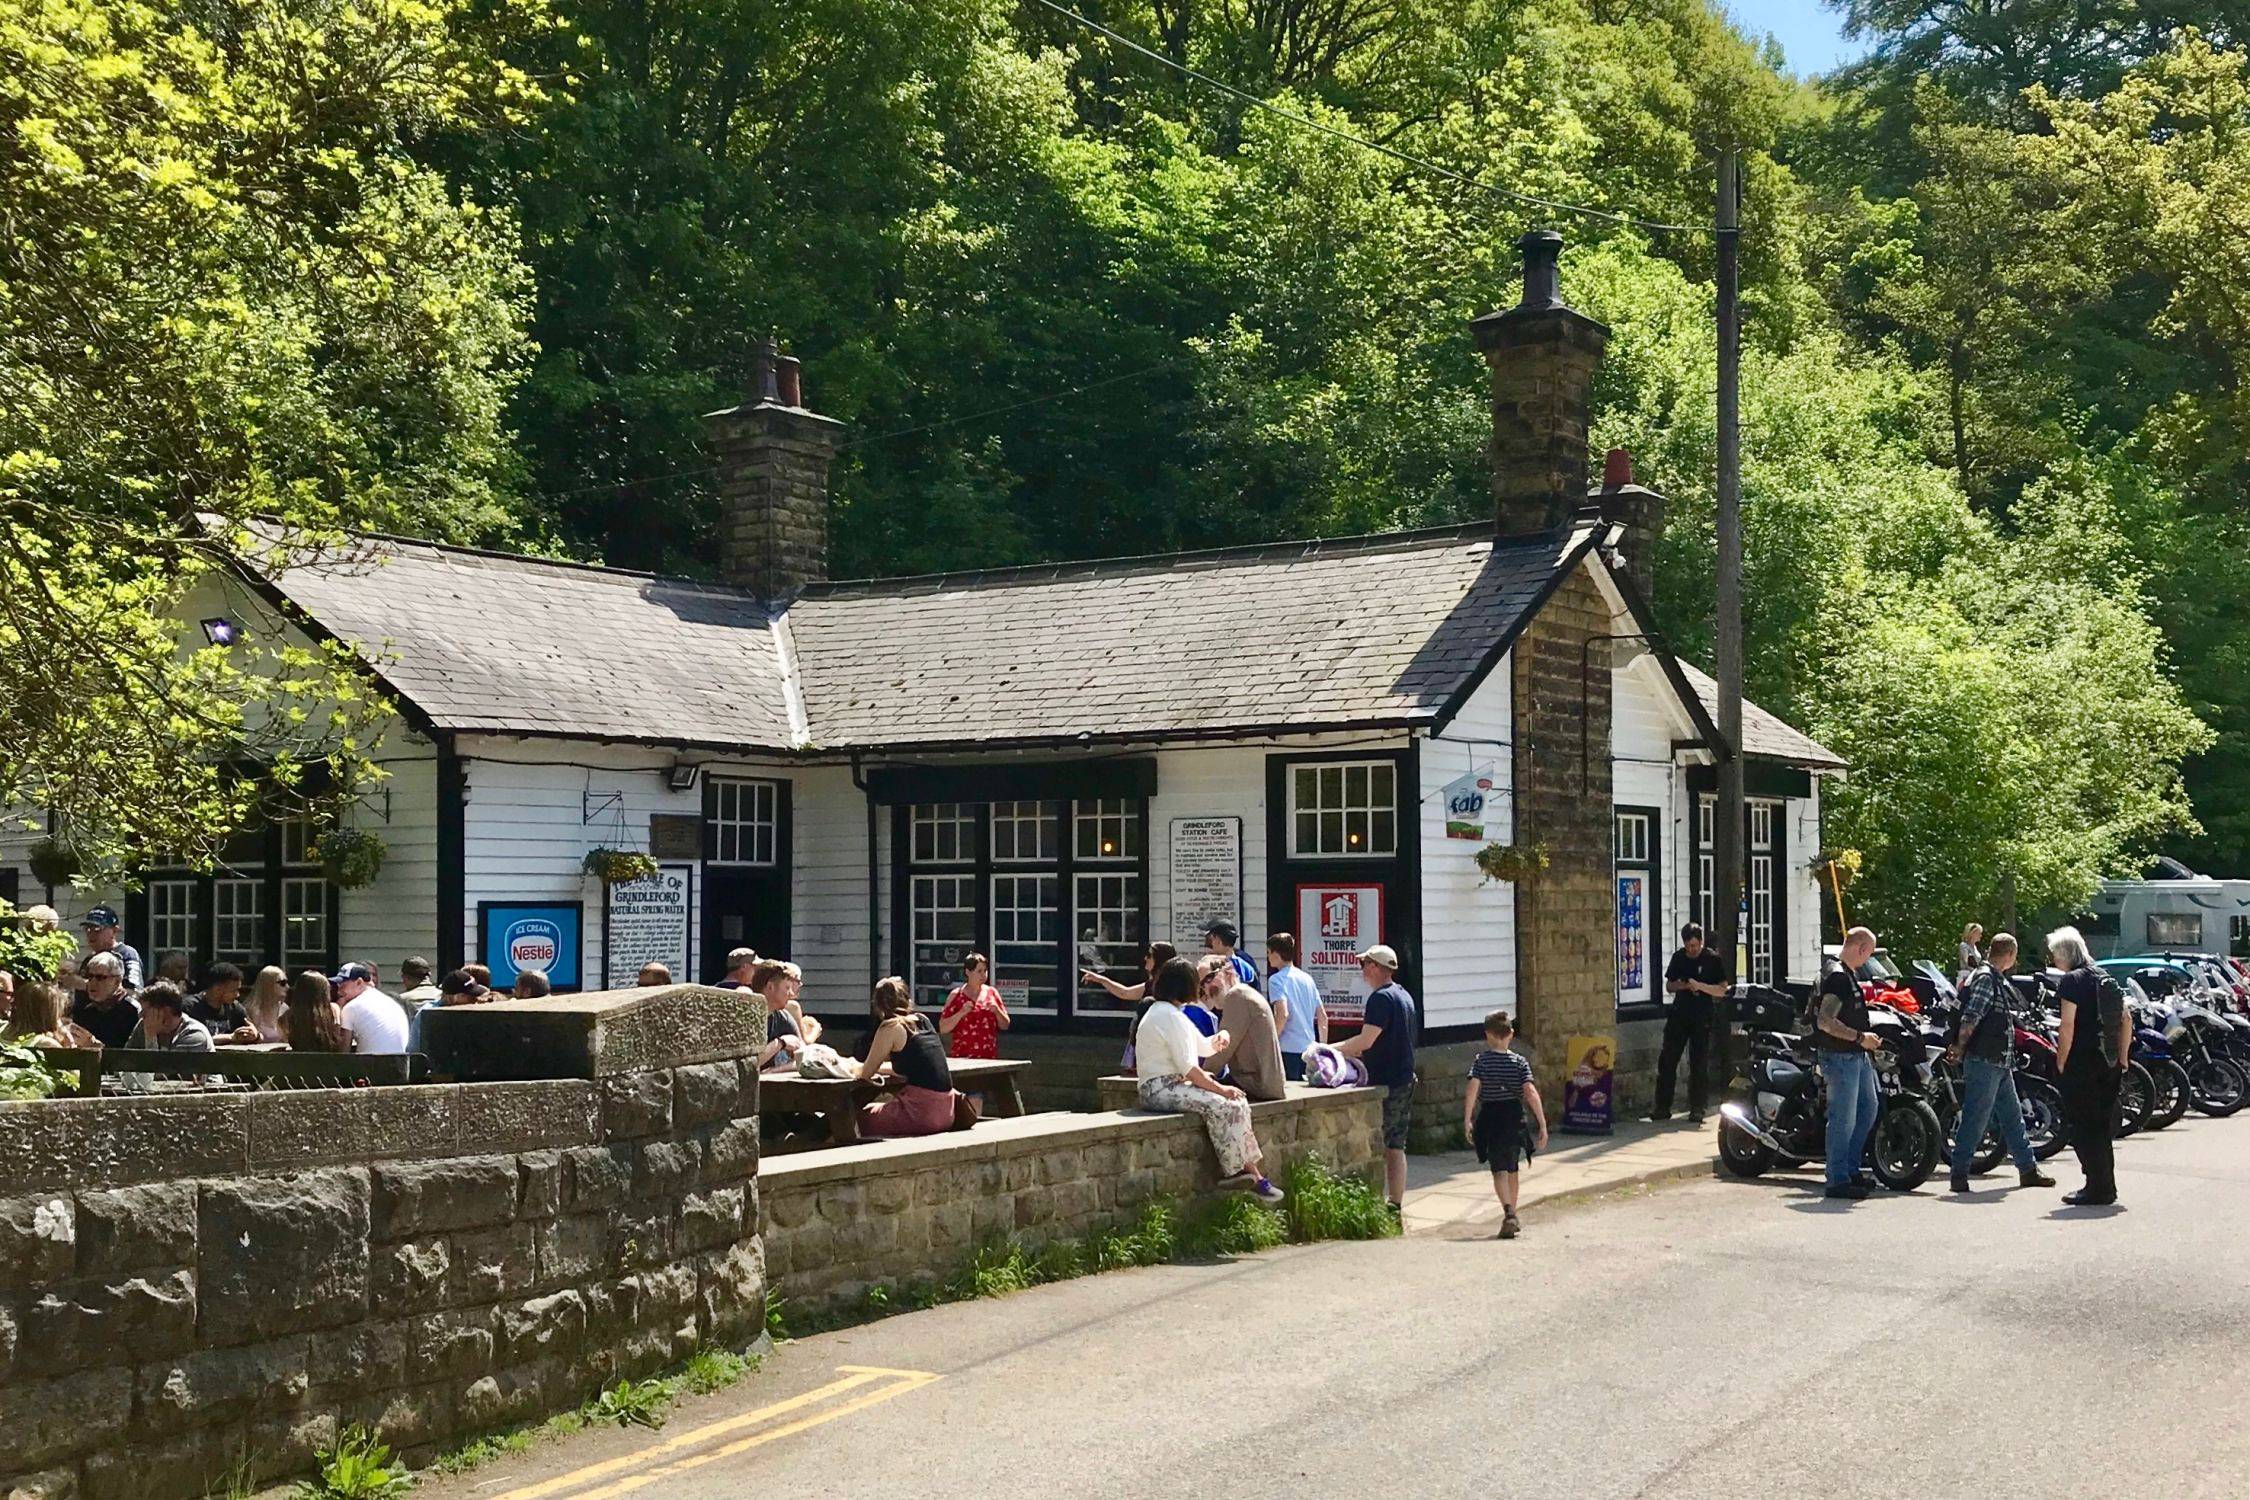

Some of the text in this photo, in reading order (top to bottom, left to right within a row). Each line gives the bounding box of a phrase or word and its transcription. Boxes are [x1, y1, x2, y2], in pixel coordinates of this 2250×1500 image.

[1449, 792, 1483, 814] fab
[1183, 821, 1226, 829] GRINDLEFORD
[667, 876, 683, 890] OF
[615, 891, 680, 904] GRINDLEFORD
[610, 904, 684, 915] NATURAL SPRING WATER
[516, 924, 550, 934] ICE CREAM
[1324, 940, 1356, 951] THORPE
